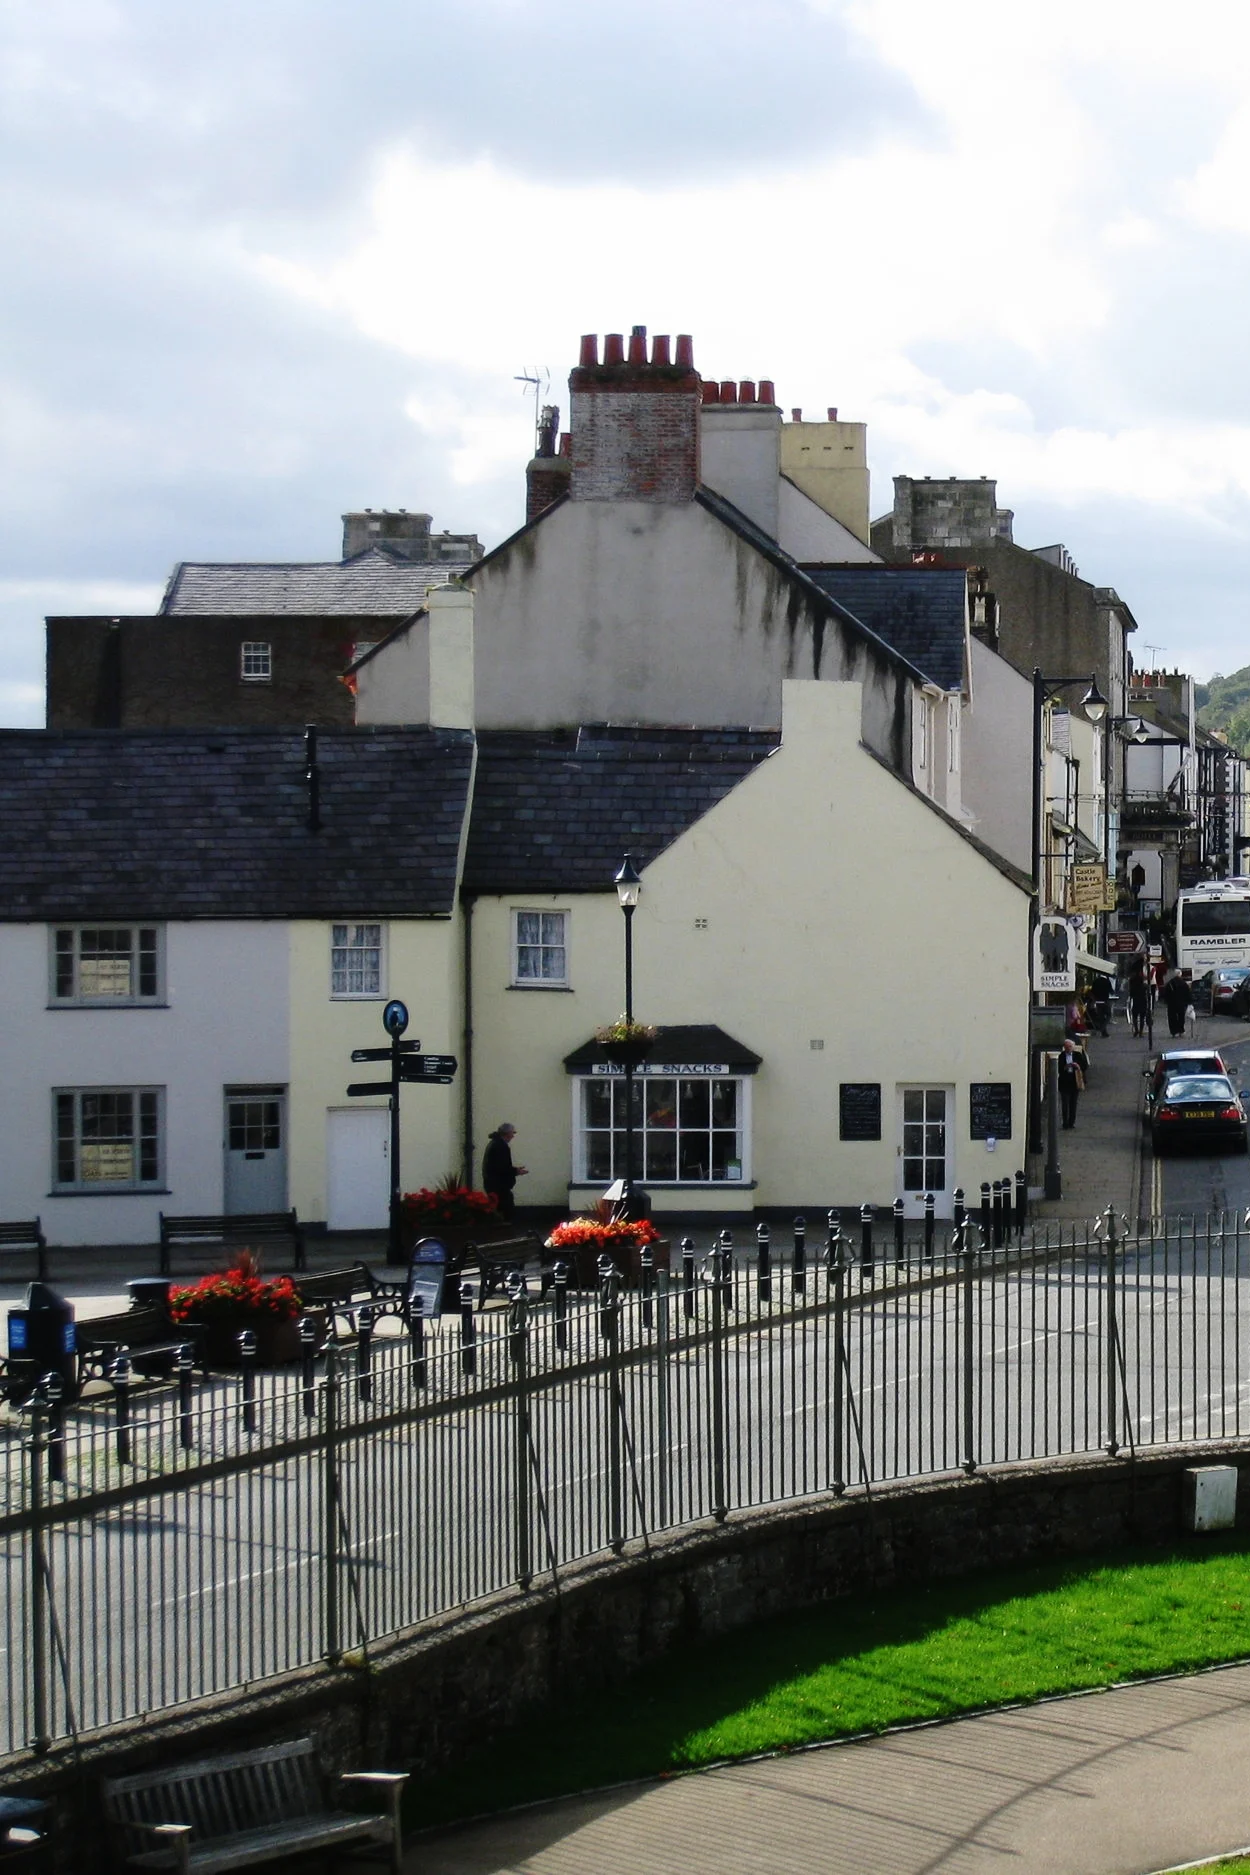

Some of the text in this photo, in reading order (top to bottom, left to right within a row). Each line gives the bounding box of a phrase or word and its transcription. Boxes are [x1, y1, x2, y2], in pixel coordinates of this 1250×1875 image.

[1190, 938, 1247, 946] RAMBLER
[598, 1064, 722, 1074] SIMLE SNACKS
